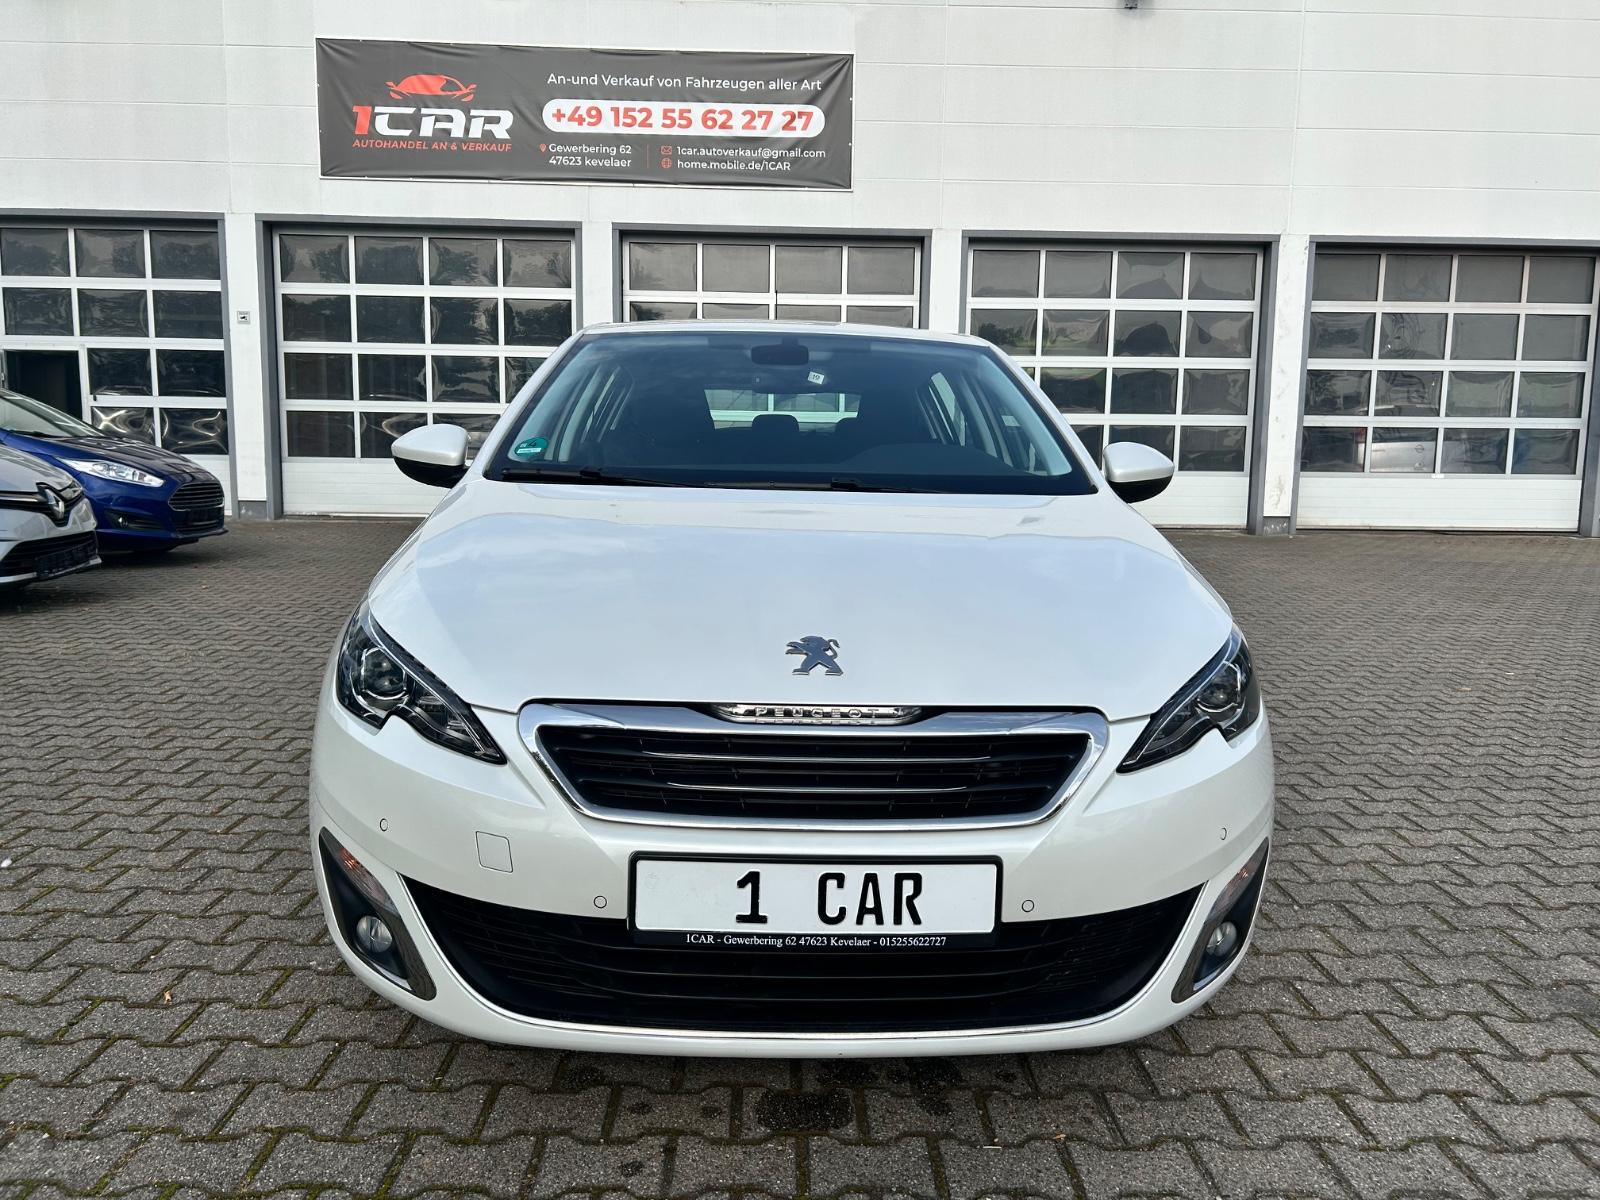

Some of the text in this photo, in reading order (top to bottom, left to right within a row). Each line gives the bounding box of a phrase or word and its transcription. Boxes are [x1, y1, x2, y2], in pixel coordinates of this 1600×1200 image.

[547, 73, 822, 91] An-und Verkauf von Fahrzeugen aller Art
[352, 105, 514, 139] 1CAR
[552, 105, 814, 131] +49 152 55 62 27 27
[352, 139, 513, 152] AUTOHANDEL AN & VERKAUF
[548, 143, 632, 156] Gewerbering 62
[676, 146, 826, 159] 1car.autoverkauf@gmail.com
[548, 156, 632, 167] 47623 kevelaer
[676, 159, 791, 171] home.mobile.de/1CAR
[754, 706, 880, 719] PEUGEOT
[735, 870, 923, 926] 1 CAR
[686, 933, 715, 944] 1CAR
[723, 934, 783, 948] Gewerbering
[785, 936, 797, 946] 62
[799, 936, 828, 946] 47623
[830, 936, 872, 946] Kevelaer
[879, 936, 947, 947] 015255622727
